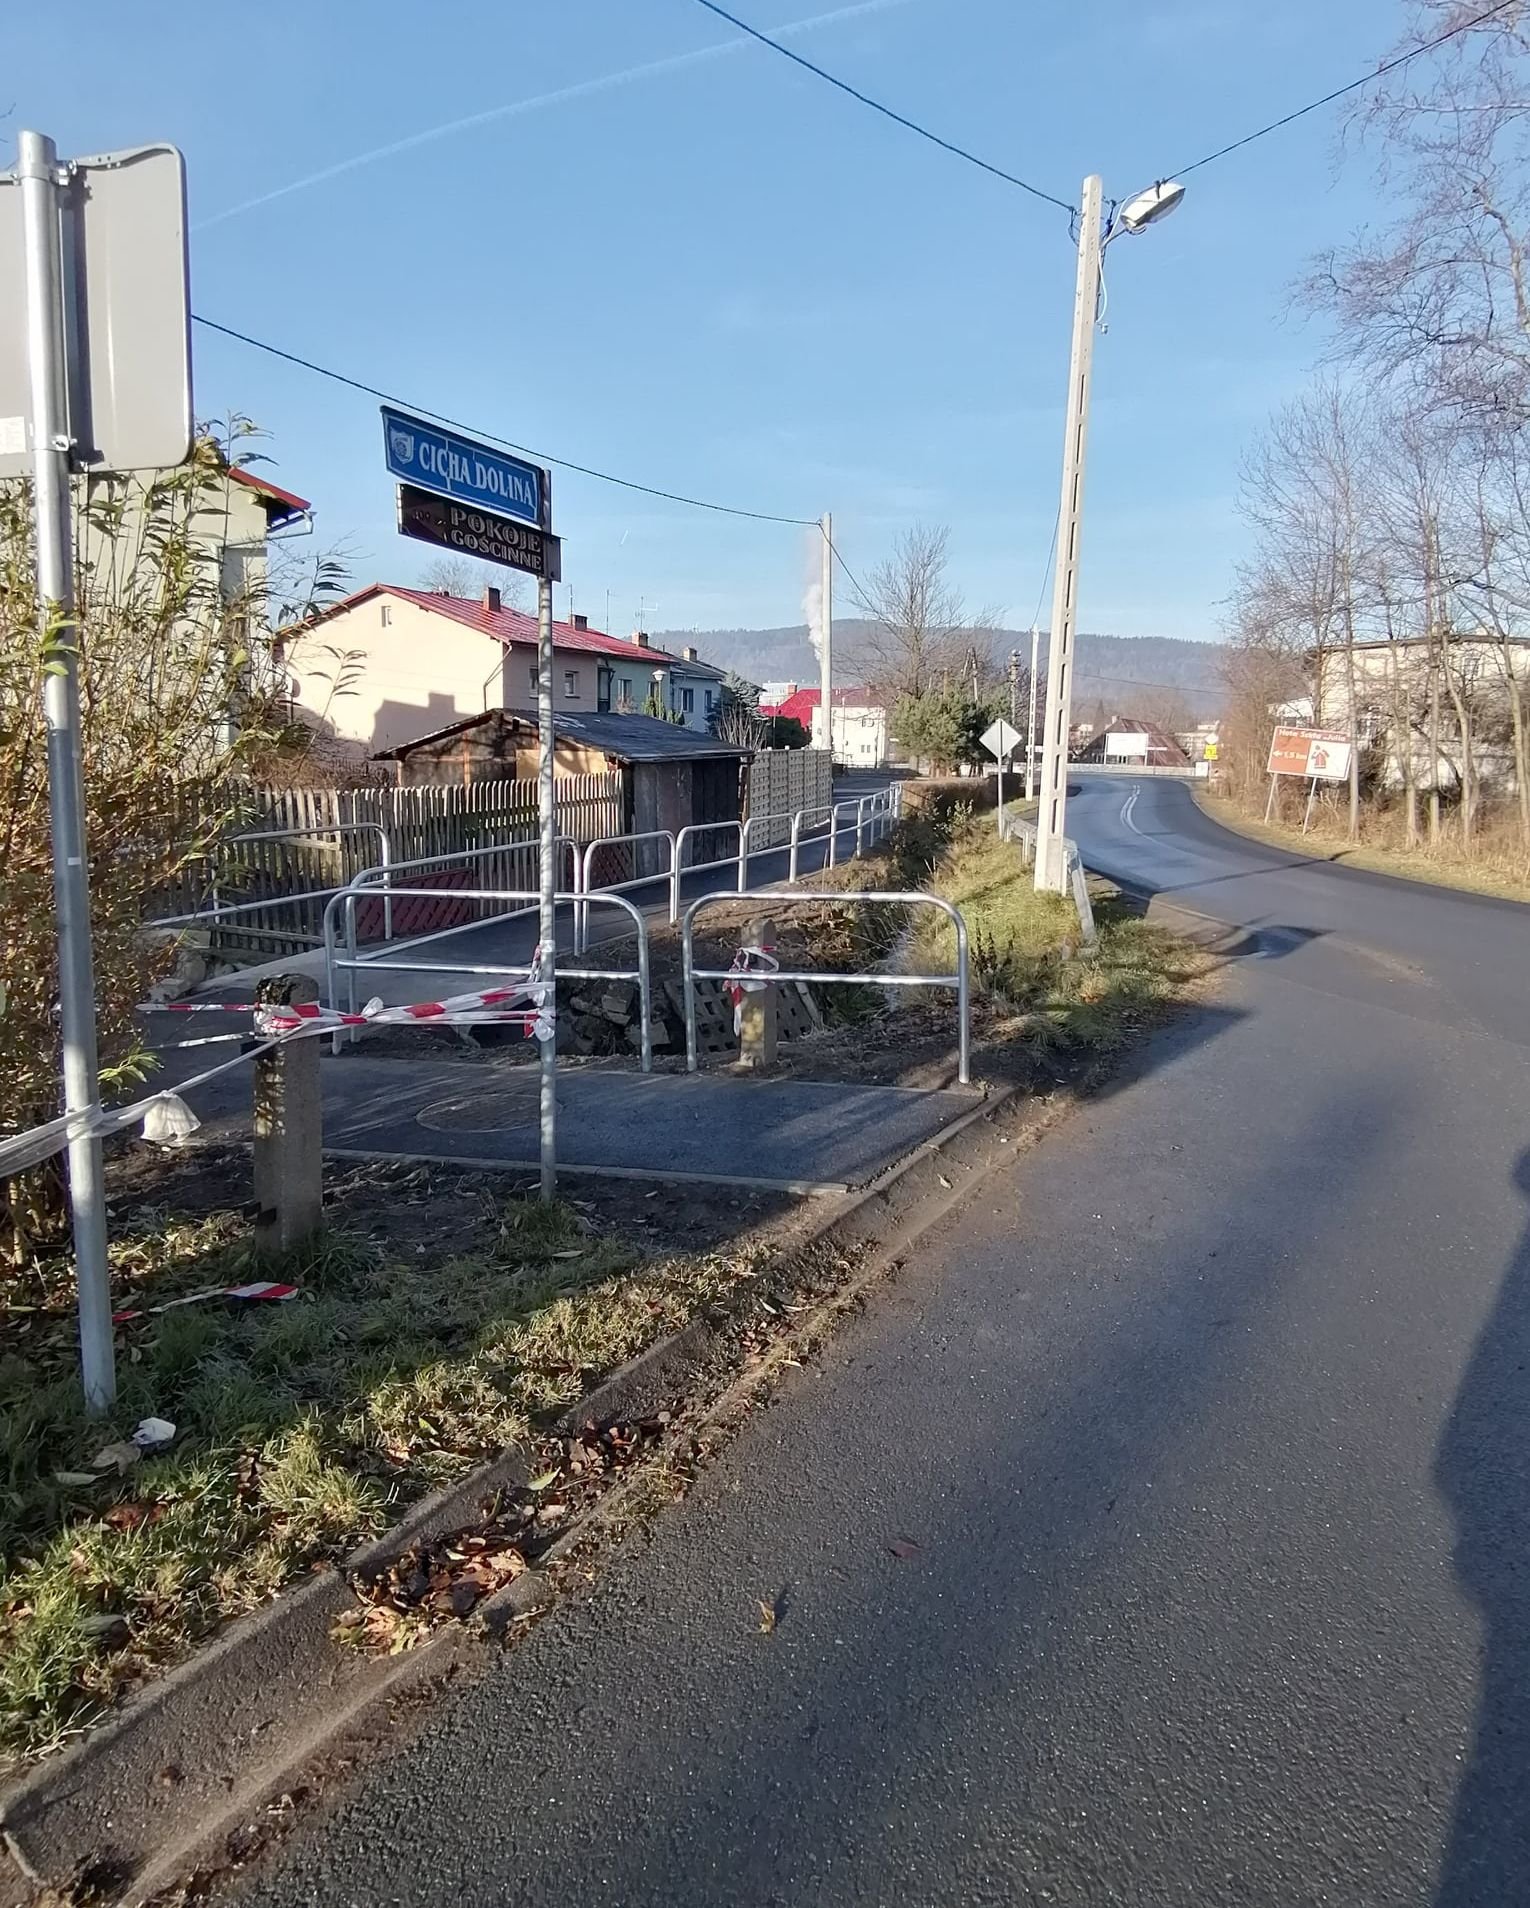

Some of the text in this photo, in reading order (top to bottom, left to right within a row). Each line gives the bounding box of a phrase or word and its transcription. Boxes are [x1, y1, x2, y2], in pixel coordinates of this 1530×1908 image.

[419, 442, 533, 506] CICHA DOLINA
[451, 507, 541, 552] POKOJE
[451, 529, 541, 569] GOŚCINNE
